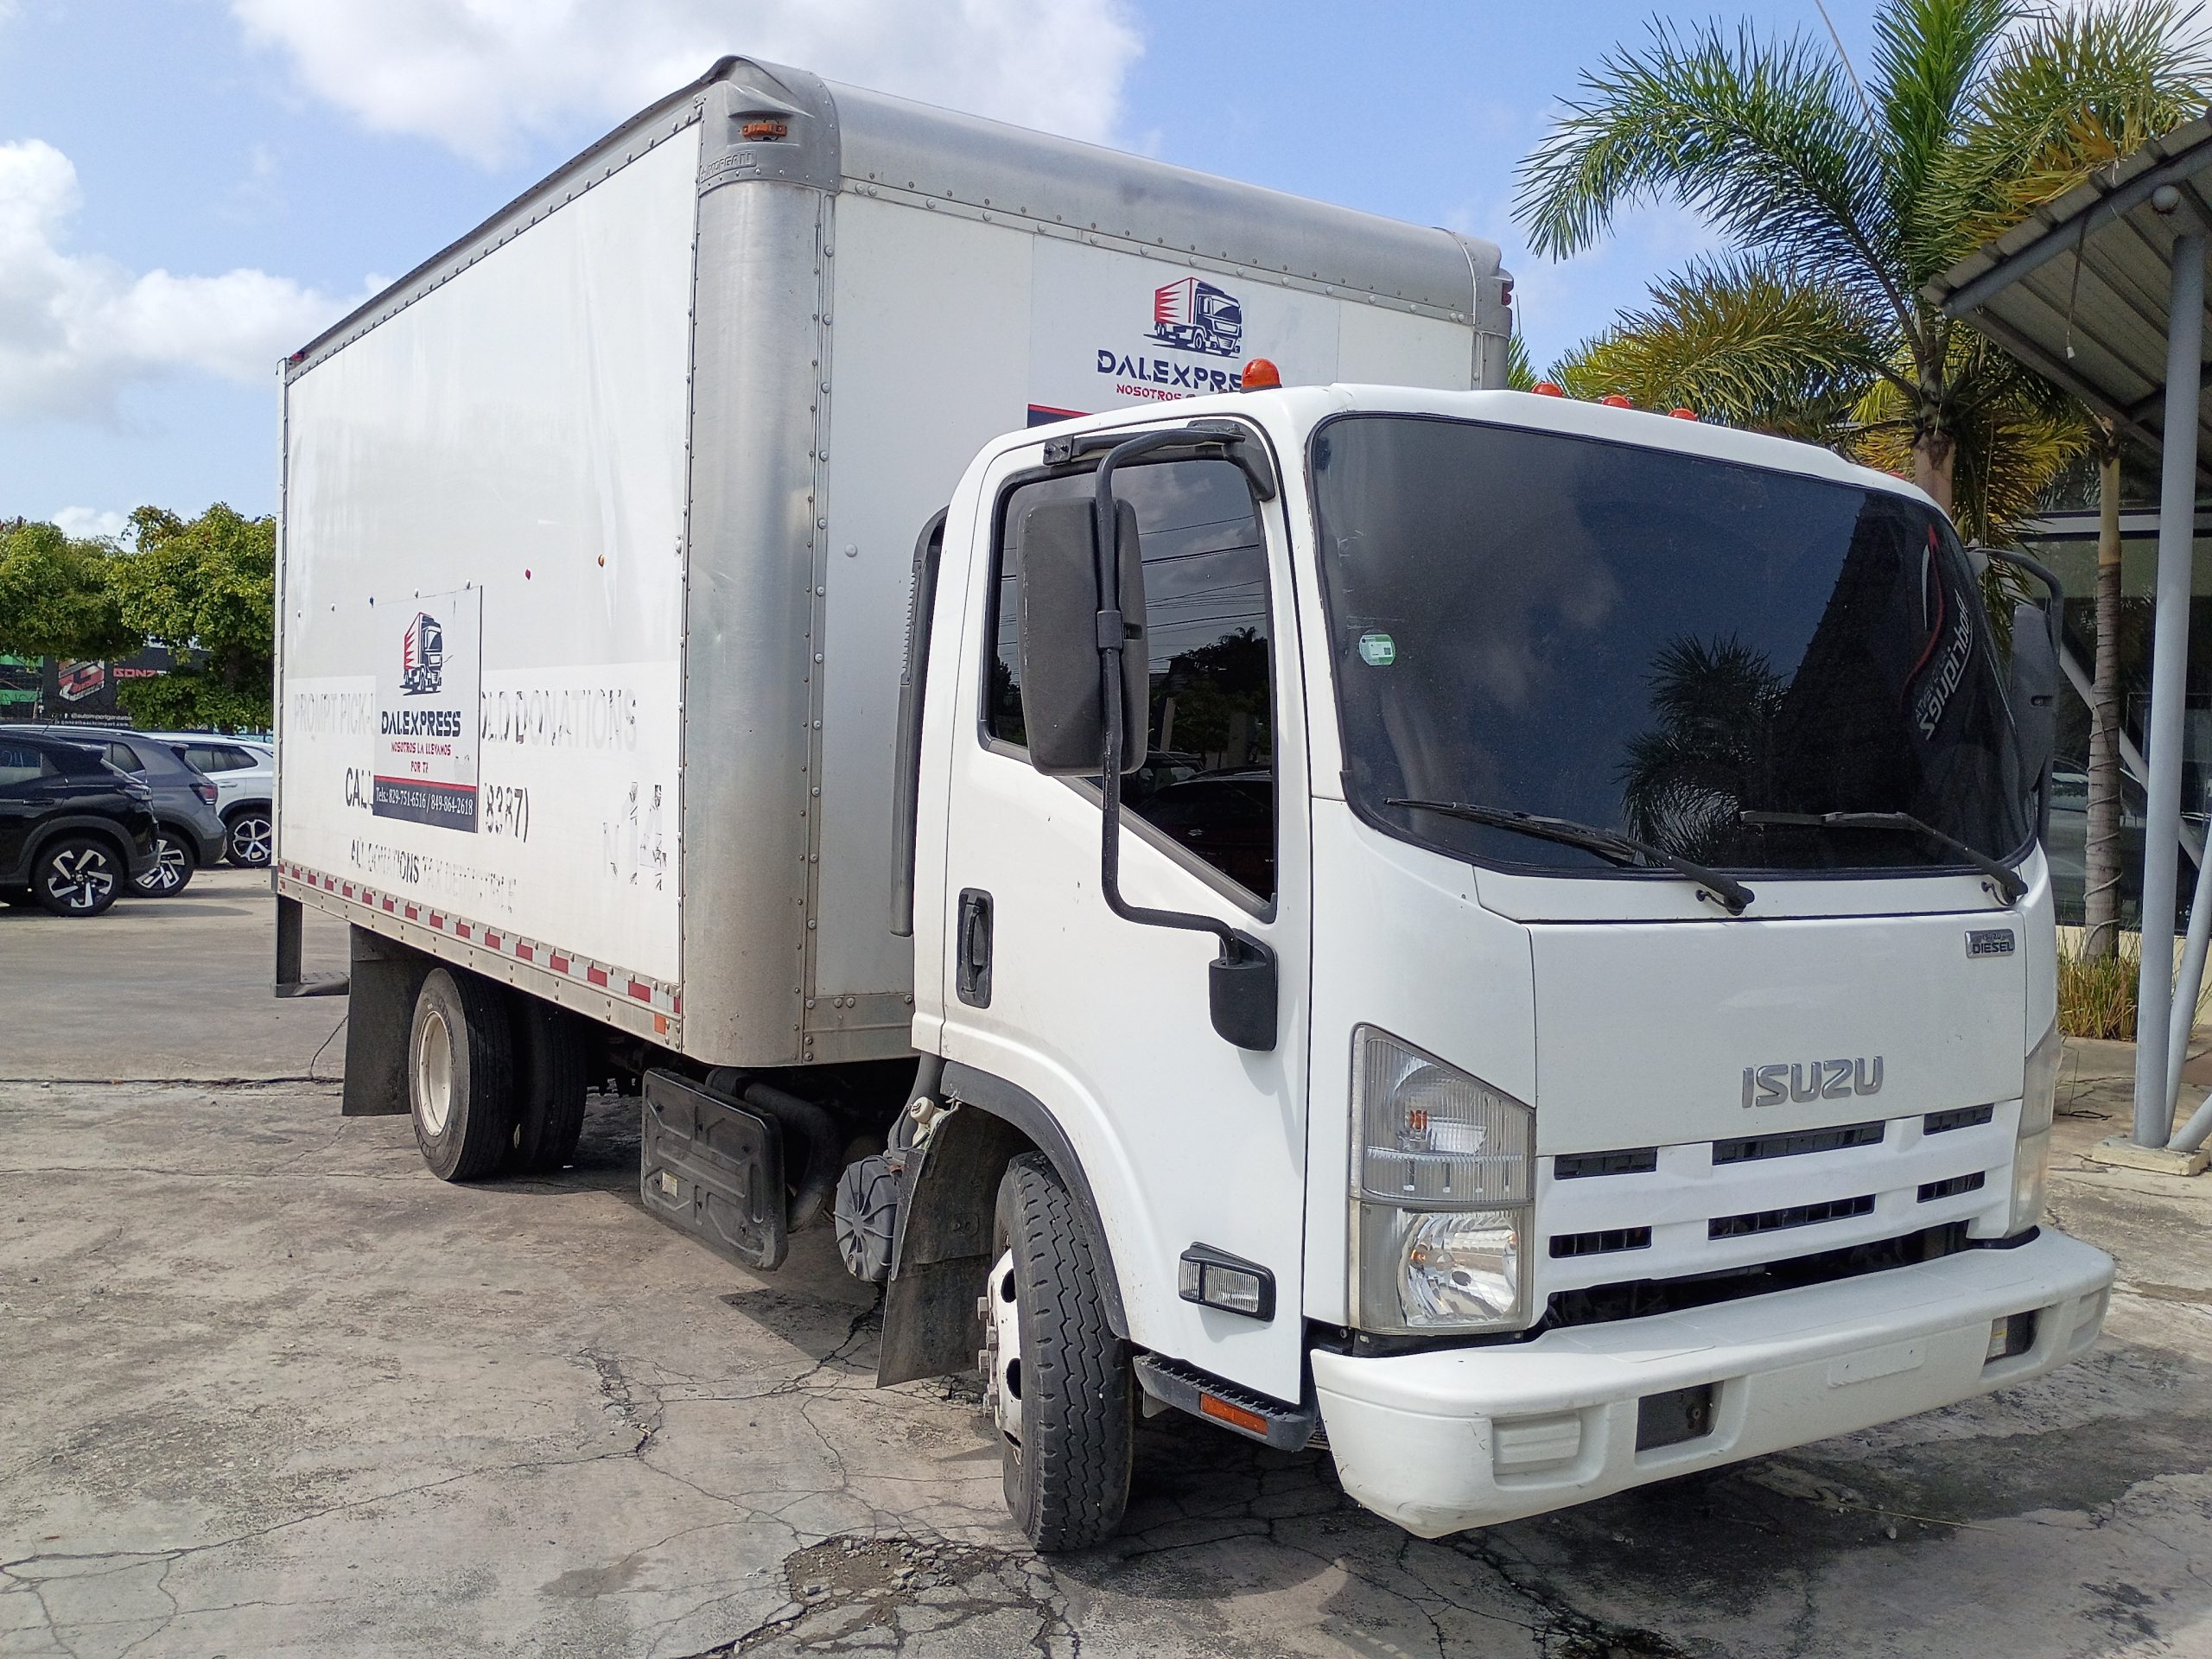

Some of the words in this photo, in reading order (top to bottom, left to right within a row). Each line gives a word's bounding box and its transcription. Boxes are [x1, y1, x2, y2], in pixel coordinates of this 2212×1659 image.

[381, 710, 461, 737] DALEXPRESS
[516, 689, 637, 752] DONATIONS
[391, 741, 416, 754] NOSOTROS
[417, 743, 424, 754] LA
[425, 744, 451, 756] LLEVAMOS
[410, 761, 421, 772] POR
[376, 787, 388, 803] Tels.:
[389, 789, 426, 808] 829-751-6516
[431, 794, 474, 816] 849-864-2618
[1973, 942, 2014, 954] DIESEL
[1741, 1055, 1884, 1109] ISUZU
